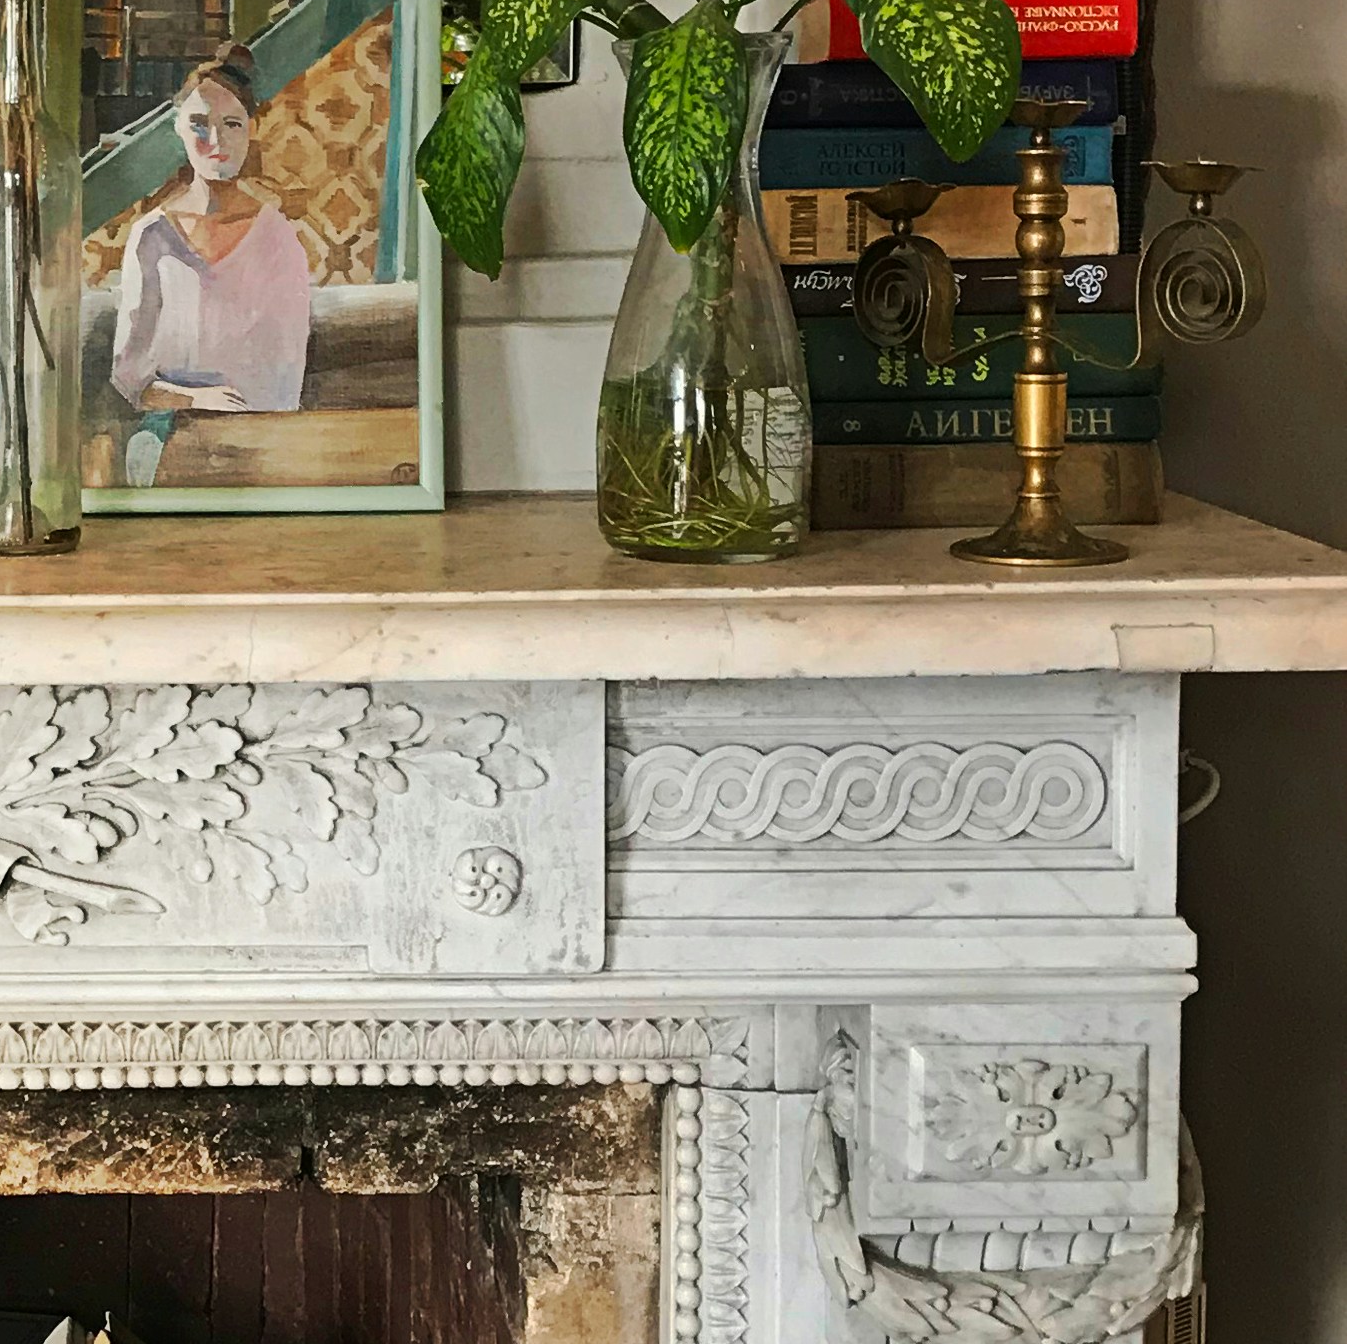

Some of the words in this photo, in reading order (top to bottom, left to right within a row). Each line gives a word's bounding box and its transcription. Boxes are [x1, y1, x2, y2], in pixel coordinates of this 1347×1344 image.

[1024, 5, 1119, 17] DICTIONNAIRE
[817, 141, 905, 159] АЛЕКСЕЙ
[905, 407, 1115, 439] А.И.ГЕЕН
